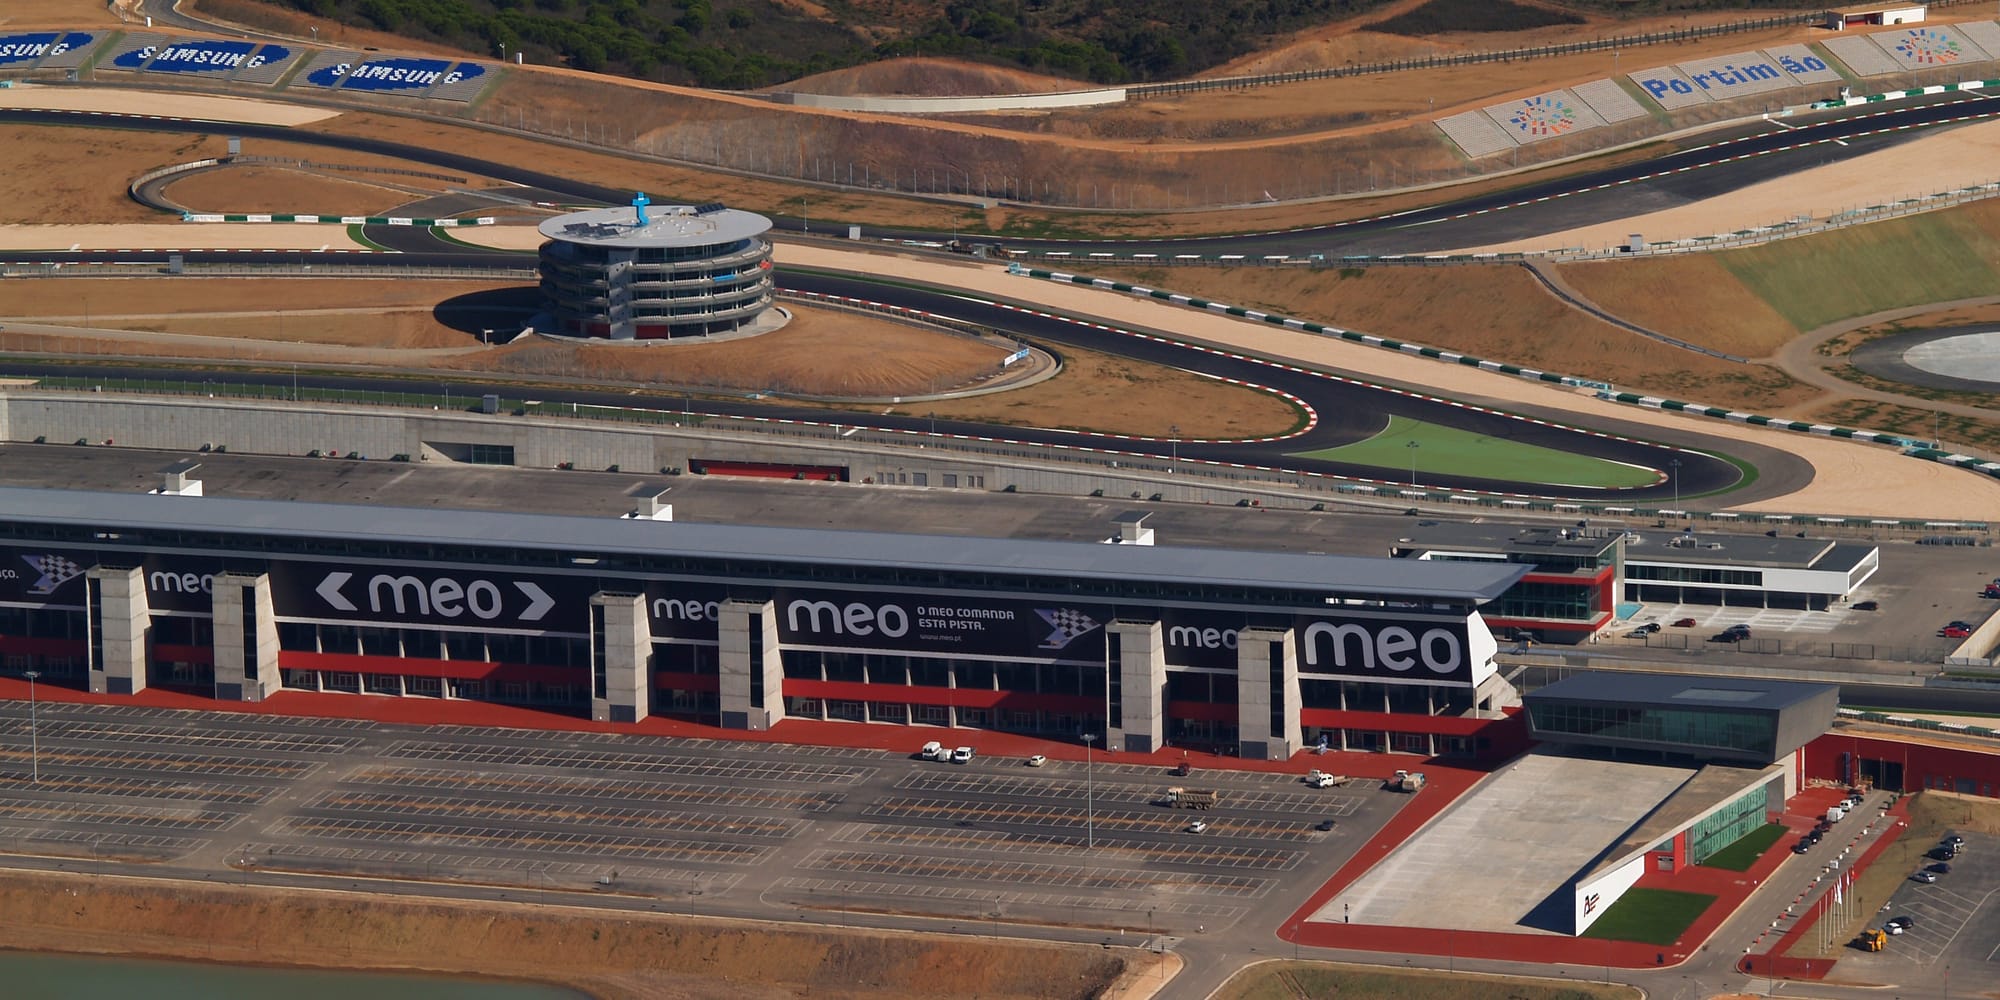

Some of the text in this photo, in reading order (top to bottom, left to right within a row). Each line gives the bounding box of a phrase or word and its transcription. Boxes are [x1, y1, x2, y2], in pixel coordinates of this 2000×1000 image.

[0, 43, 69, 56] SUNG
[138, 46, 266, 68] SAMSUNG
[332, 63, 463, 84] SAMSUNG
[1642, 55, 1827, 99] Portimão
[0, 569, 19, 580] ço.
[150, 571, 213, 594] meo
[368, 574, 502, 619] meo
[653, 598, 719, 622] meo
[787, 599, 909, 638] meo
[917, 606, 1014, 619] O MEO COMANDA
[919, 618, 985, 630] ESTA PISTA.
[1169, 626, 1238, 650] meo
[1304, 622, 1461, 674] meo
